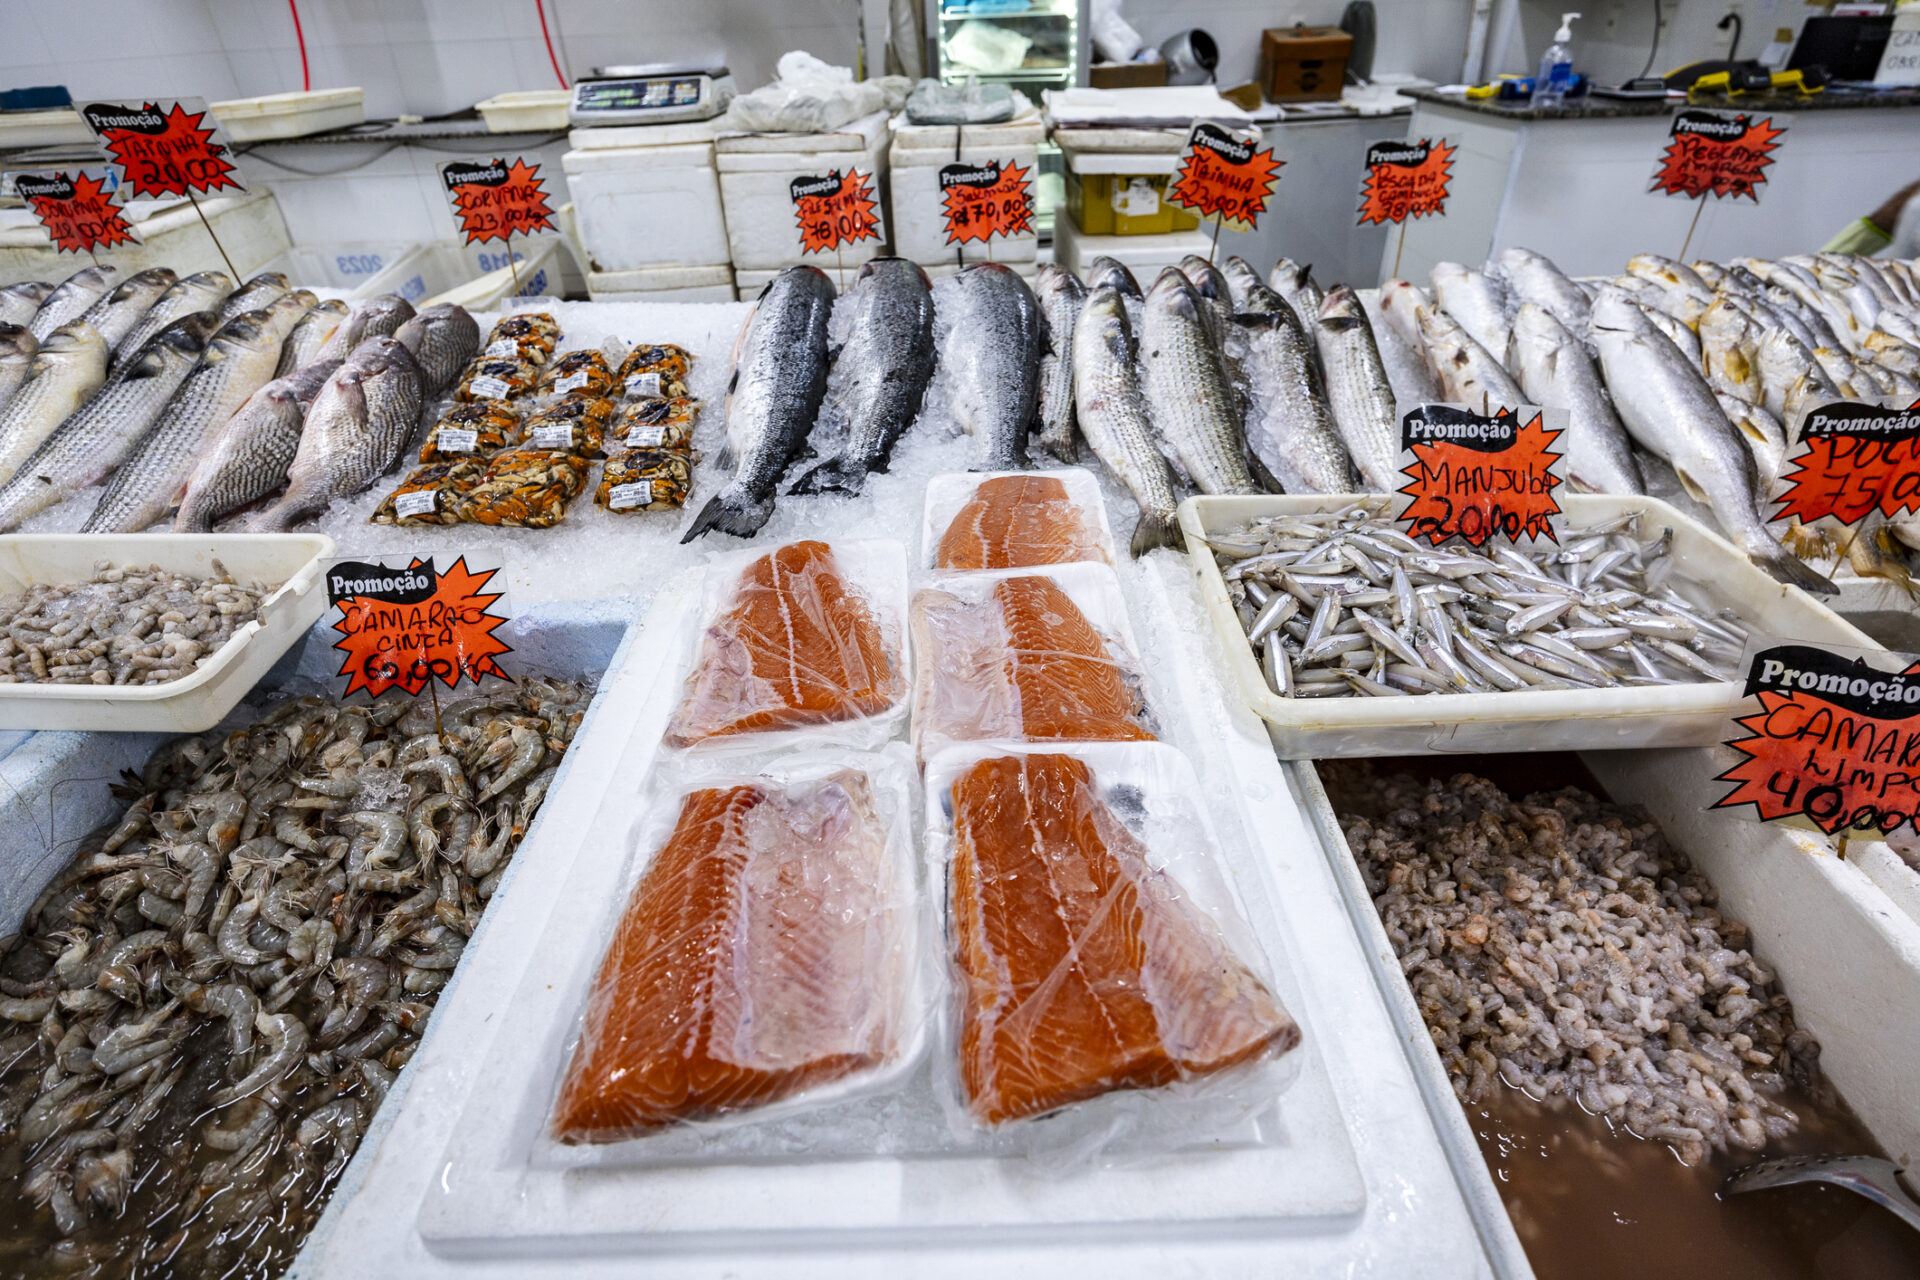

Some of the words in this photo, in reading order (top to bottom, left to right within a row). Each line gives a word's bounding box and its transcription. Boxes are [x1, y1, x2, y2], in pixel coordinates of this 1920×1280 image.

[88, 109, 163, 130] Promoção
[1676, 117, 1744, 137] Promoção
[115, 133, 199, 160] TAINHA
[1194, 129, 1251, 161] Promoção
[1370, 147, 1428, 164] Promoção
[446, 166, 505, 185] Promoção
[942, 168, 997, 185] Promoção
[1192, 154, 1255, 193] TAINHA
[19, 179, 71, 201] Promoção
[461, 185, 535, 210] CORVINA
[792, 177, 839, 197] Promoção
[970, 199, 1022, 223] 70,00
[1409, 419, 1511, 443] Promoção
[1808, 411, 1920, 434] Promoção
[332, 570, 429, 595] Promoção
[1759, 659, 1920, 705] Promoção
[1764, 703, 1920, 768] CAMAR
